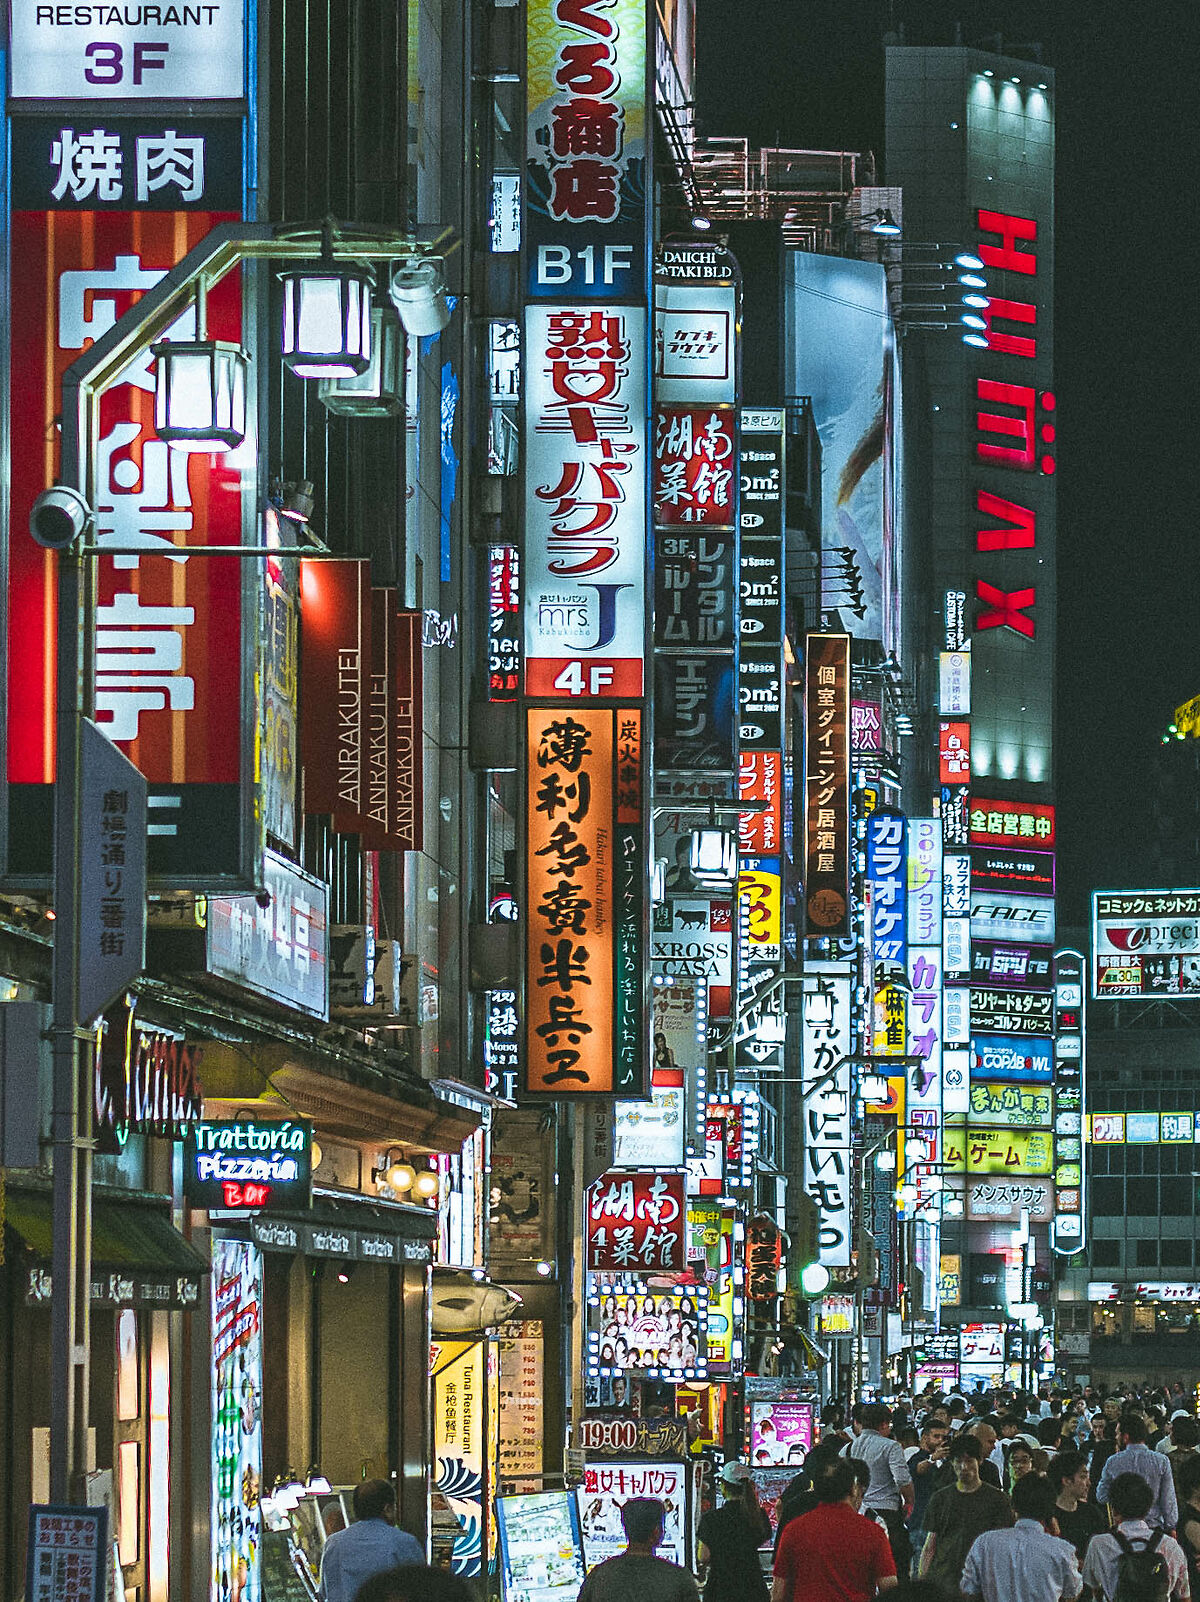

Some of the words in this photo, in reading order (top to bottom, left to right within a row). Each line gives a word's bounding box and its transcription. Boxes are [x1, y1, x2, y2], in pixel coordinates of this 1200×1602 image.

[36, 5, 220, 26] RESTAURANT
[84, 42, 170, 85] 3F
[51, 129, 205, 201] 焼肉
[537, 244, 634, 285] B1F
[664, 251, 717, 264] DAIICHI
[703, 266, 732, 278] BLD
[656, 413, 733, 461] 湖南
[680, 508, 708, 522] 4F
[743, 516, 757, 526] 5F
[664, 539, 690, 555] 3F
[664, 564, 691, 641] ルーム
[697, 537, 726, 641] レンタル
[743, 621, 757, 631] 4F
[554, 661, 615, 695] 4F
[675, 659, 708, 737] エデン
[338, 647, 360, 804] ANRAKUTEI
[743, 728, 758, 738] 3F
[367, 673, 388, 823] ANRAKUTEI
[396, 696, 414, 842] ANRAKUTEI
[816, 665, 836, 873] 個室ダイニング居酒屋
[970, 810, 1052, 839] 全店営業中
[872, 816, 902, 938] カラオケ
[955, 857, 969, 909] カラオケ
[971, 905, 1052, 923] FACE
[653, 943, 729, 959] XROSS
[662, 960, 721, 977] CASA
[971, 1085, 1049, 1114] まんが喫茶
[970, 1143, 1021, 1166] ゲーム
[222, 1181, 272, 1207] Bar
[591, 1178, 680, 1227] 湖南
[972, 1183, 1047, 1203] メンズサウナ
[612, 1226, 679, 1268] 菜館
[463, 1364, 474, 1390] Tuna
[463, 1393, 474, 1455] Restaurant
[580, 1421, 637, 1450] 19:00
